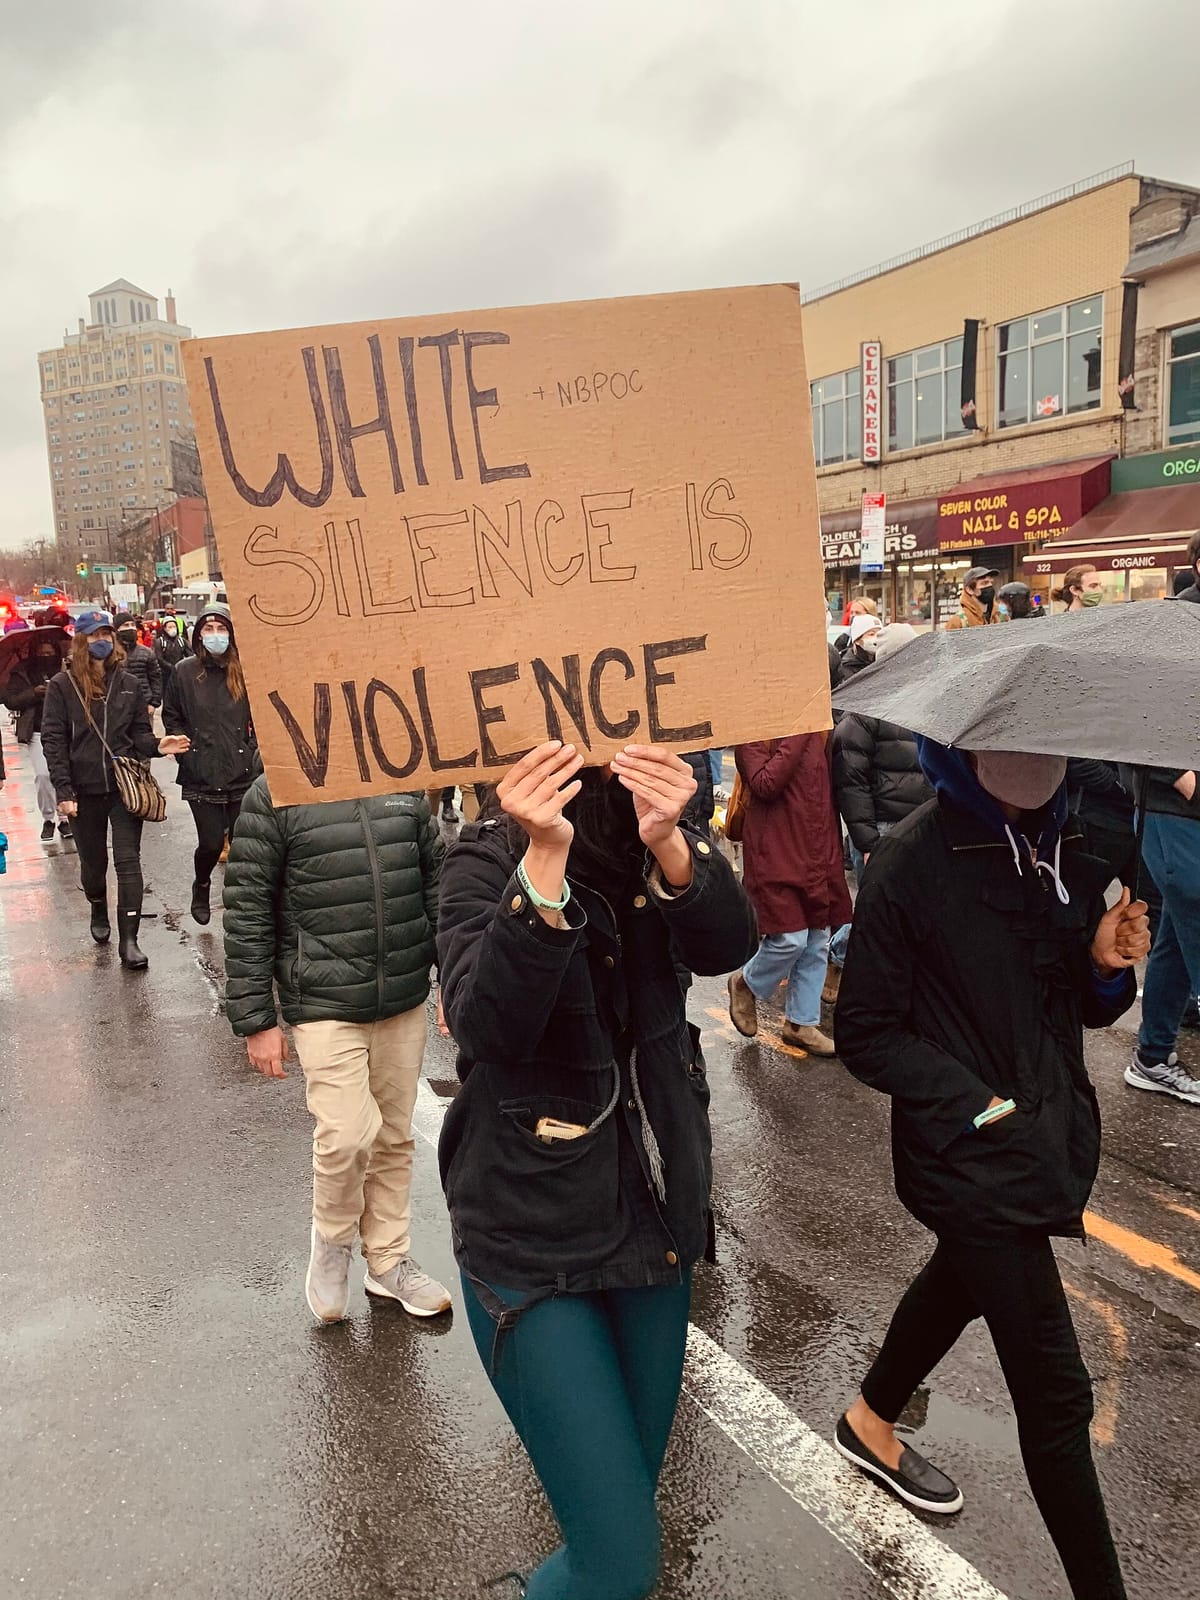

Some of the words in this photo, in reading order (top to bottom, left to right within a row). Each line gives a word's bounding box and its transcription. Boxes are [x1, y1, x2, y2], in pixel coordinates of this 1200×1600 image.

[865, 346, 877, 457] CLEANERS
[203, 329, 531, 508] WHITE
[557, 369, 643, 408] NBPOC
[940, 500, 972, 517] SEVEN
[974, 494, 1008, 511] COLOR
[962, 514, 1003, 535] NAIL
[1008, 511, 1019, 530] &
[1025, 505, 1062, 527] SPA
[822, 530, 857, 544] OLDEN
[243, 488, 637, 627] SILENCE
[685, 478, 752, 571] IS
[1111, 556, 1156, 569] ORGANIC
[1036, 563, 1052, 573] 322
[268, 633, 715, 788] VIOLENCE
